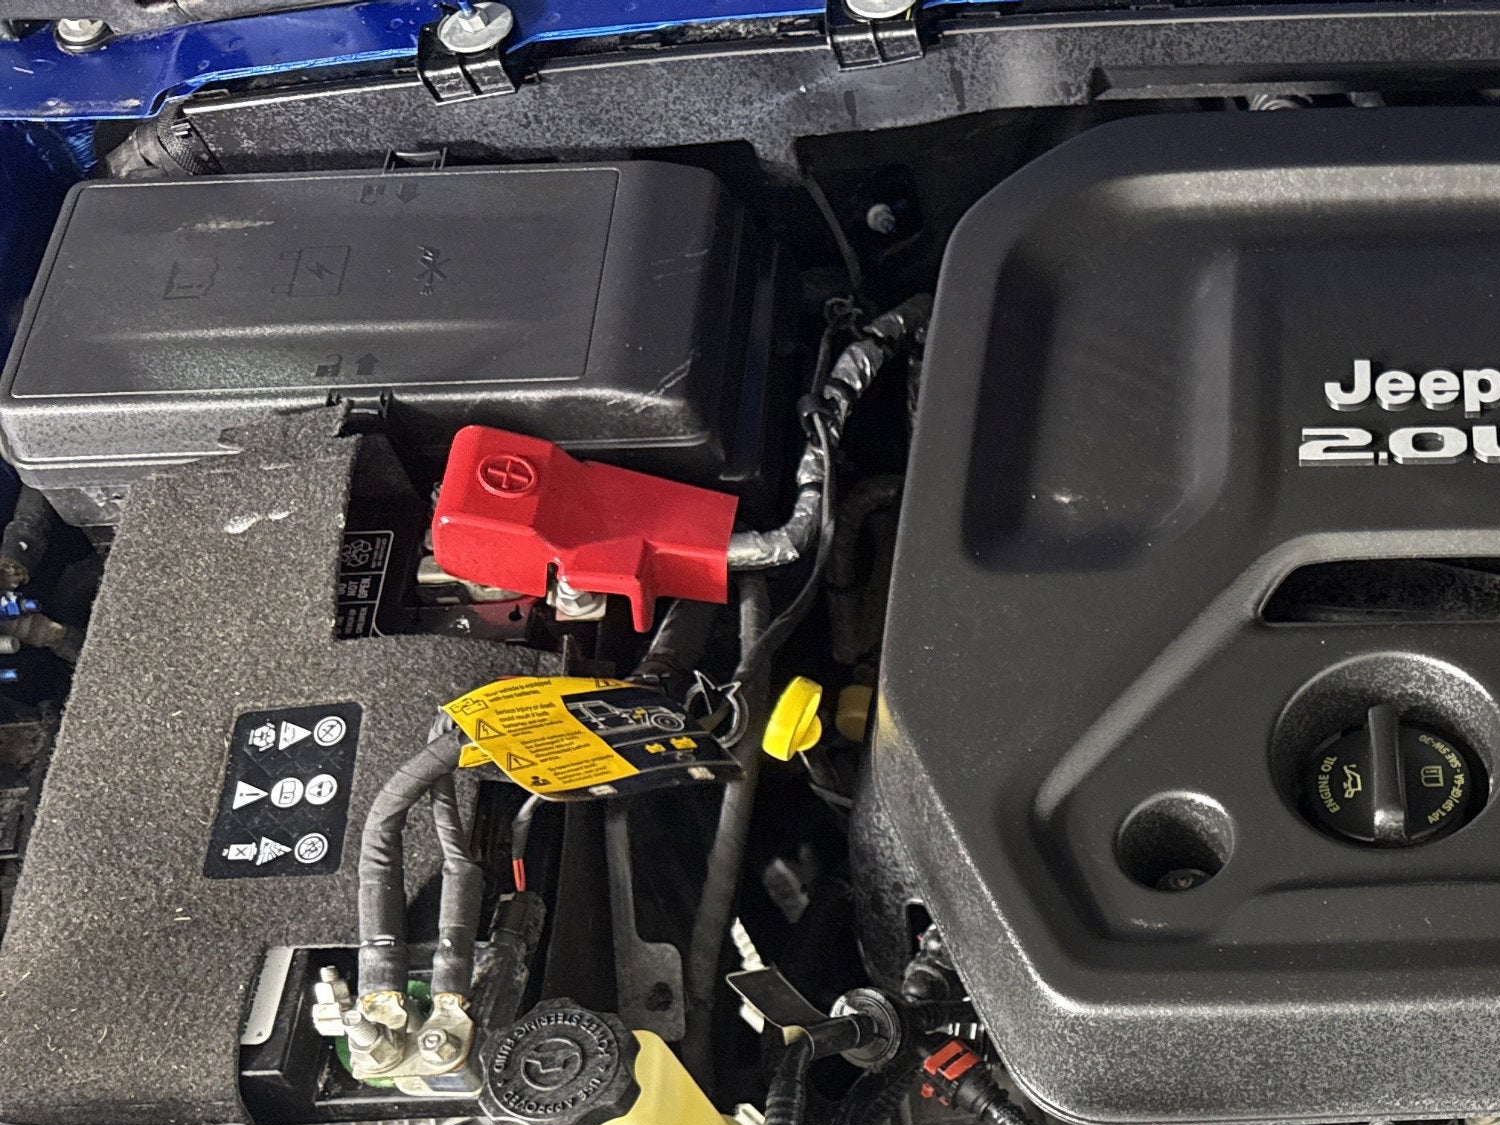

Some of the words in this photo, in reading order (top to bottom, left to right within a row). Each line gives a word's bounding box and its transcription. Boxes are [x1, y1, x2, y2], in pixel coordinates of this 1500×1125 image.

[346, 581, 358, 596] NOT
[1418, 735, 1450, 755] 5W-30
[1320, 756, 1337, 773] OIL
[1445, 754, 1462, 769] SAE
[1318, 774, 1341, 813] ENGINE
[1427, 808, 1447, 824] API
[515, 1013, 580, 1038] STEERING
[494, 1038, 514, 1073] FLUID
[577, 1078, 601, 1101] USE
[503, 1091, 576, 1114] APPROVED
